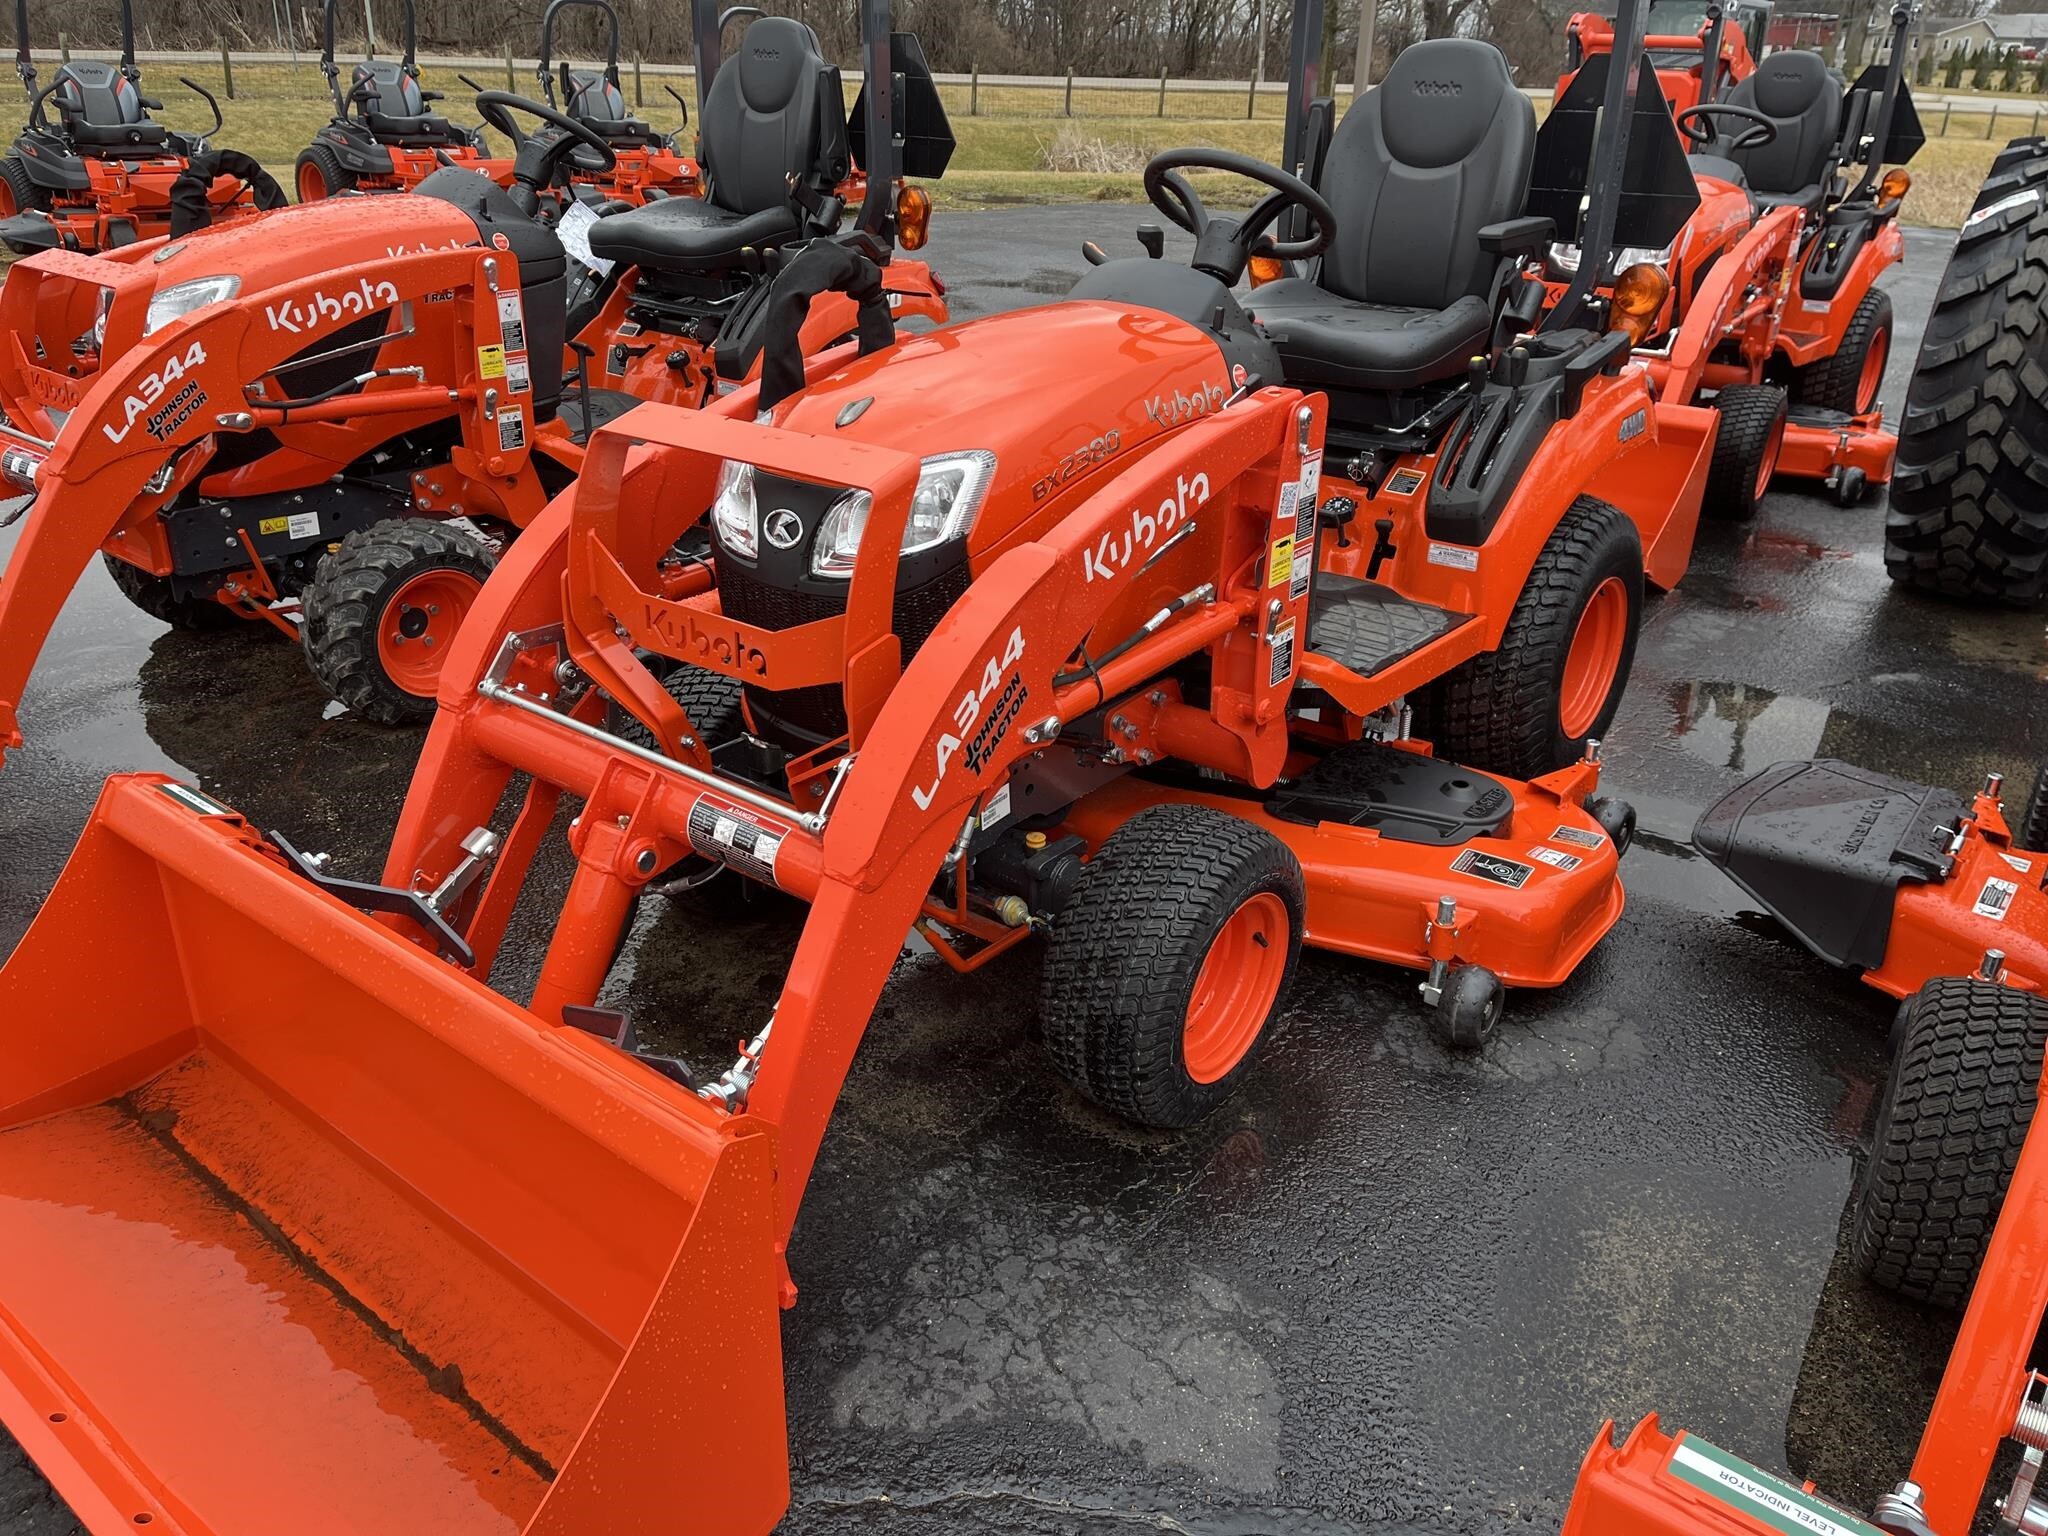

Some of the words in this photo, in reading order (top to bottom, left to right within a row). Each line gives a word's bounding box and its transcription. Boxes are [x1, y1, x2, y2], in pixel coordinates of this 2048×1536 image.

[1414, 80, 1463, 97] Kubota
[265, 278, 399, 334] Kubota
[102, 340, 207, 444] LA344
[146, 380, 199, 434] JOHNSON
[152, 391, 208, 443] TRACTOR
[1144, 380, 1226, 428] Kubota
[1031, 428, 1121, 503] BX2380
[1083, 472, 1210, 583] Kubota
[644, 604, 768, 678] Kubota
[911, 625, 1026, 811] LA344
[964, 671, 1022, 768] JOHNSON
[970, 685, 1028, 777] TRACTOR
[734, 807, 759, 823] DANGER
[1719, 1470, 1791, 1512] INDICATOR
[1794, 1508, 1836, 1535] LEVEL
